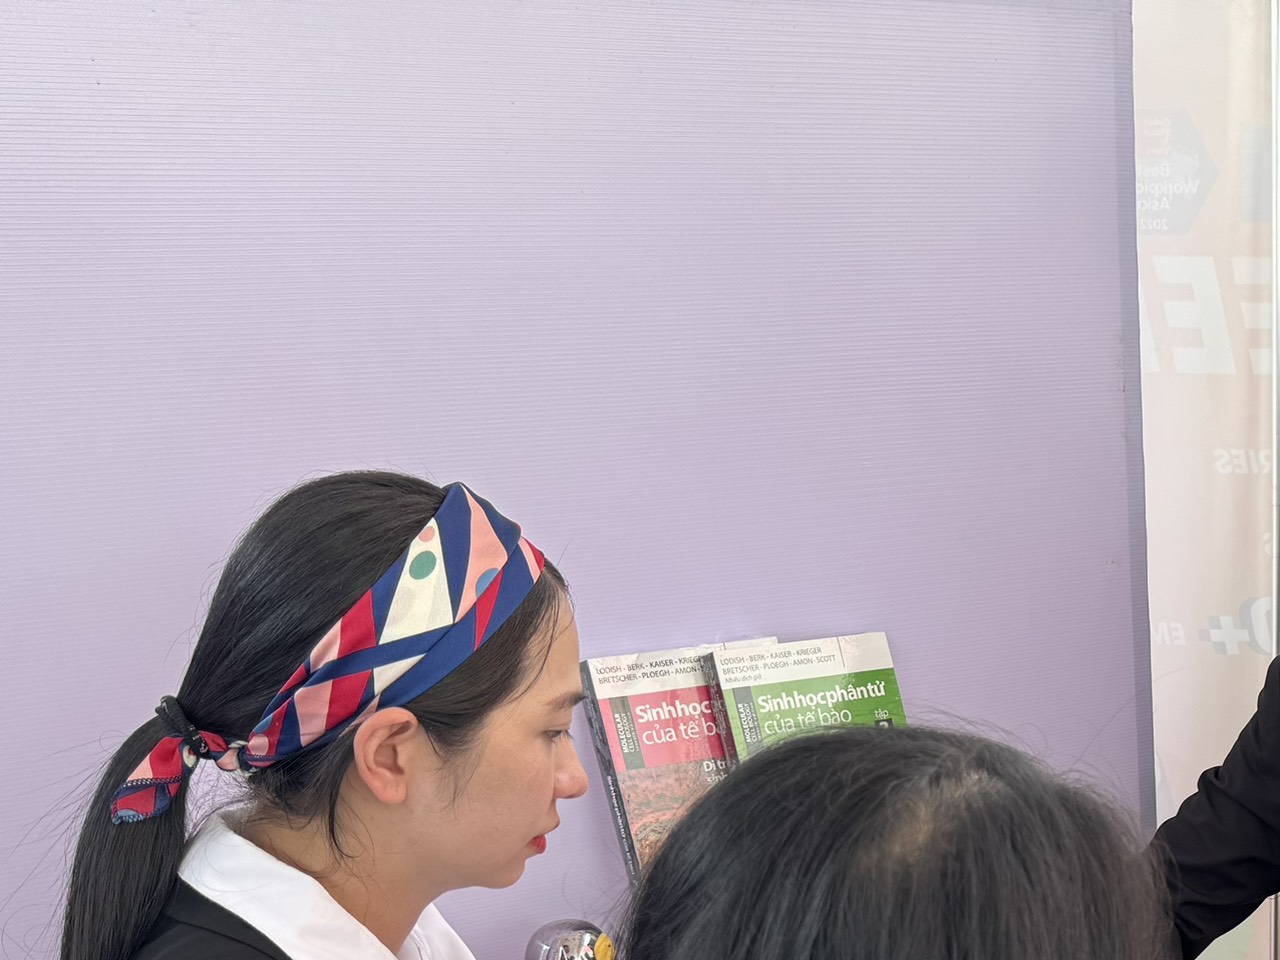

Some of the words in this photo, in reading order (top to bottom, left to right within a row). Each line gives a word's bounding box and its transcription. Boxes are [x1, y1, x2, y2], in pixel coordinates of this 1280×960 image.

[720, 656, 745, 666] LODISH
[749, 652, 766, 663] BERK
[770, 650, 792, 660] KAISER
[796, 646, 823, 657] KRIEGER
[722, 664, 759, 676] BRETSCHER
[763, 660, 789, 670] PLOEGH
[792, 657, 814, 667] AMON
[816, 654, 837, 664] SCOTT
[596, 664, 622, 675] LODISH
[627, 662, 645, 672] BERK
[650, 660, 675, 669] KAISER
[598, 674, 639, 685] BRETSCHER
[642, 670, 671, 680] PLOEGH
[675, 665, 697, 675] AMON
[737, 703, 752, 743] MOLECULAR
[819, 707, 853, 726] bào
[614, 713, 629, 753] MOLECULAR
[642, 723, 677, 745] của
[679, 719, 700, 740] tế
